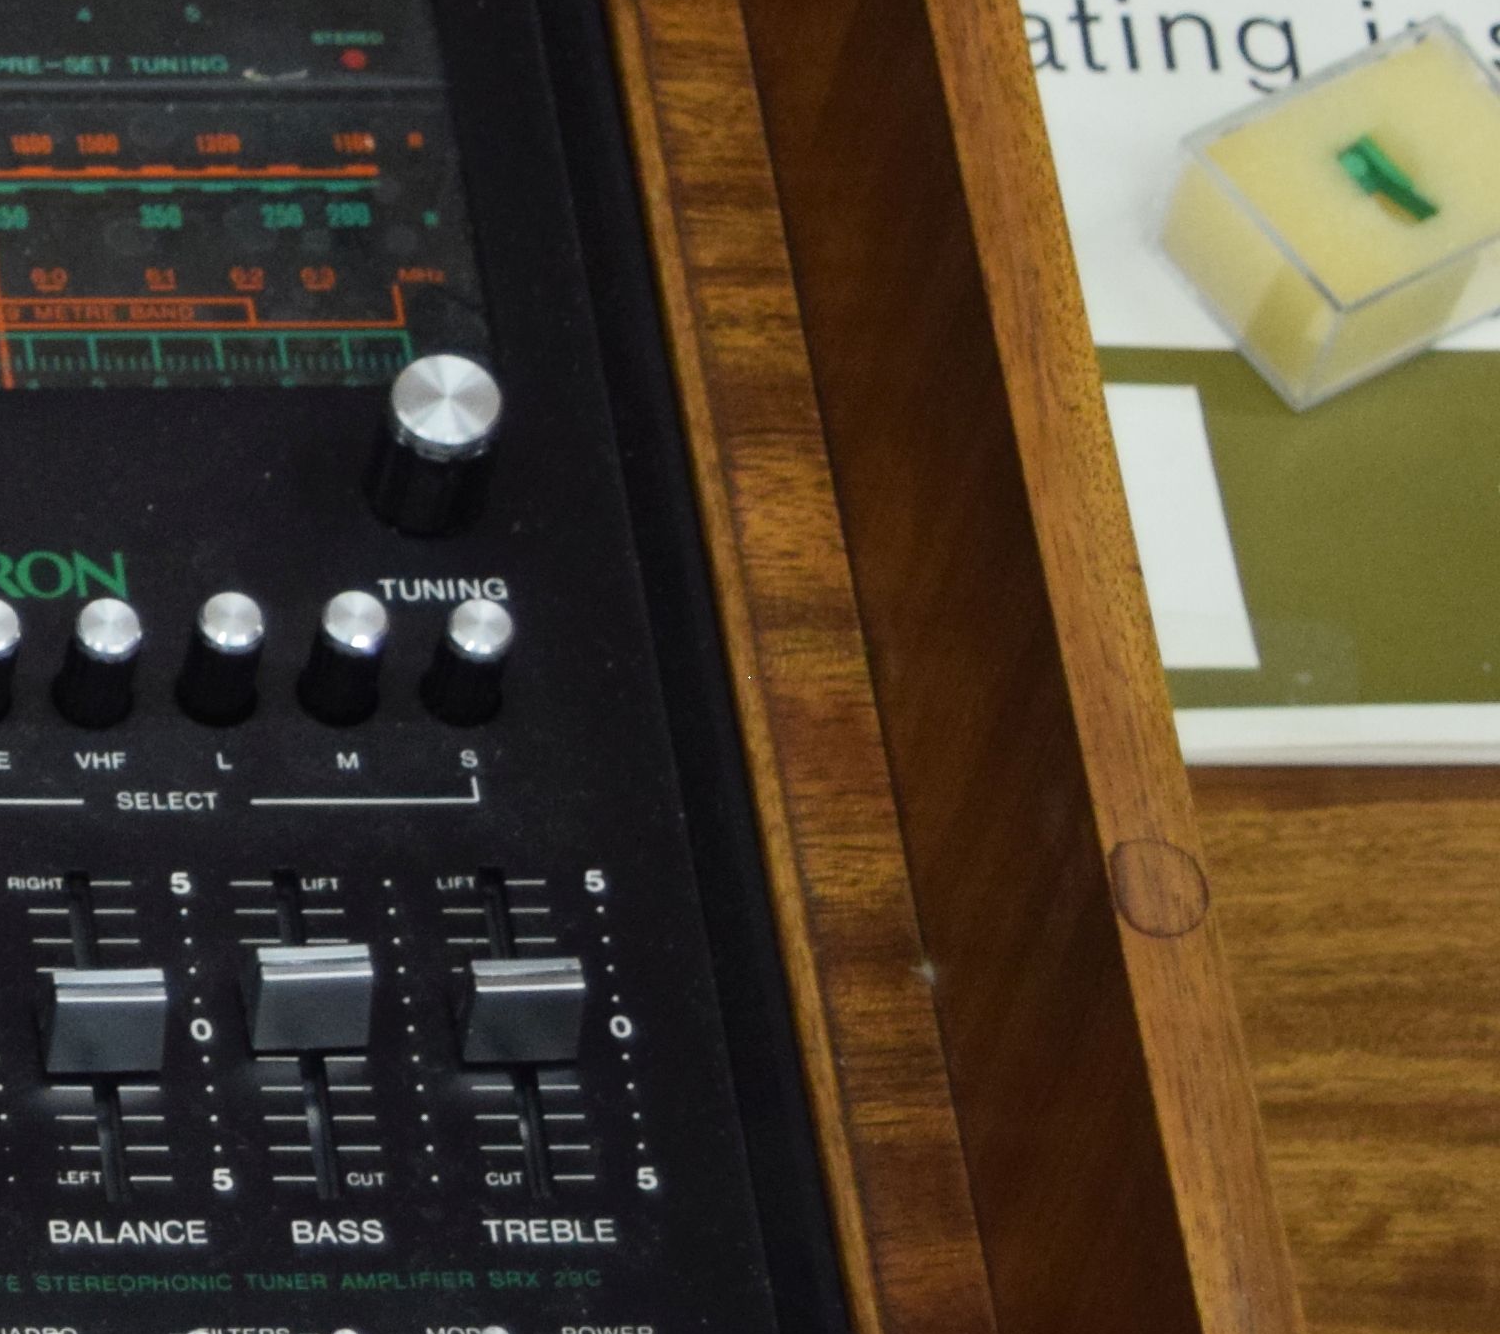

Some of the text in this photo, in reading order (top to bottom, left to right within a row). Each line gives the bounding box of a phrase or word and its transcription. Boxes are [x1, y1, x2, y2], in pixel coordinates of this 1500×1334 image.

[77, 8, 91, 21] 4
[185, 5, 201, 22] 5
[130, 56, 229, 73] TUNING
[375, 576, 511, 605] TUNING
[75, 752, 125, 769] VHF
[216, 753, 232, 770] L
[336, 752, 359, 769] M
[460, 749, 478, 768] S
[117, 791, 217, 810] SELECT
[7, 877, 62, 890] RIGHT
[171, 872, 191, 894] 5
[301, 878, 338, 891] LIFT
[436, 876, 475, 890] LIFT
[585, 870, 606, 893] 5
[190, 1018, 213, 1041] 0
[610, 1015, 632, 1038] 0
[58, 1171, 101, 1185] LEFT
[213, 1168, 234, 1191] 5
[346, 1172, 384, 1187] CUT
[485, 1171, 522, 1186] CUT
[637, 1167, 658, 1190] 5
[49, 1220, 208, 1245] BALANCE
[291, 1219, 385, 1244] BASS
[483, 1219, 616, 1243] TREBLE
[35, 1273, 233, 1293] STEREOPHONIC
[245, 1273, 327, 1291] TUNER
[341, 1271, 475, 1290] AMPLIFIER
